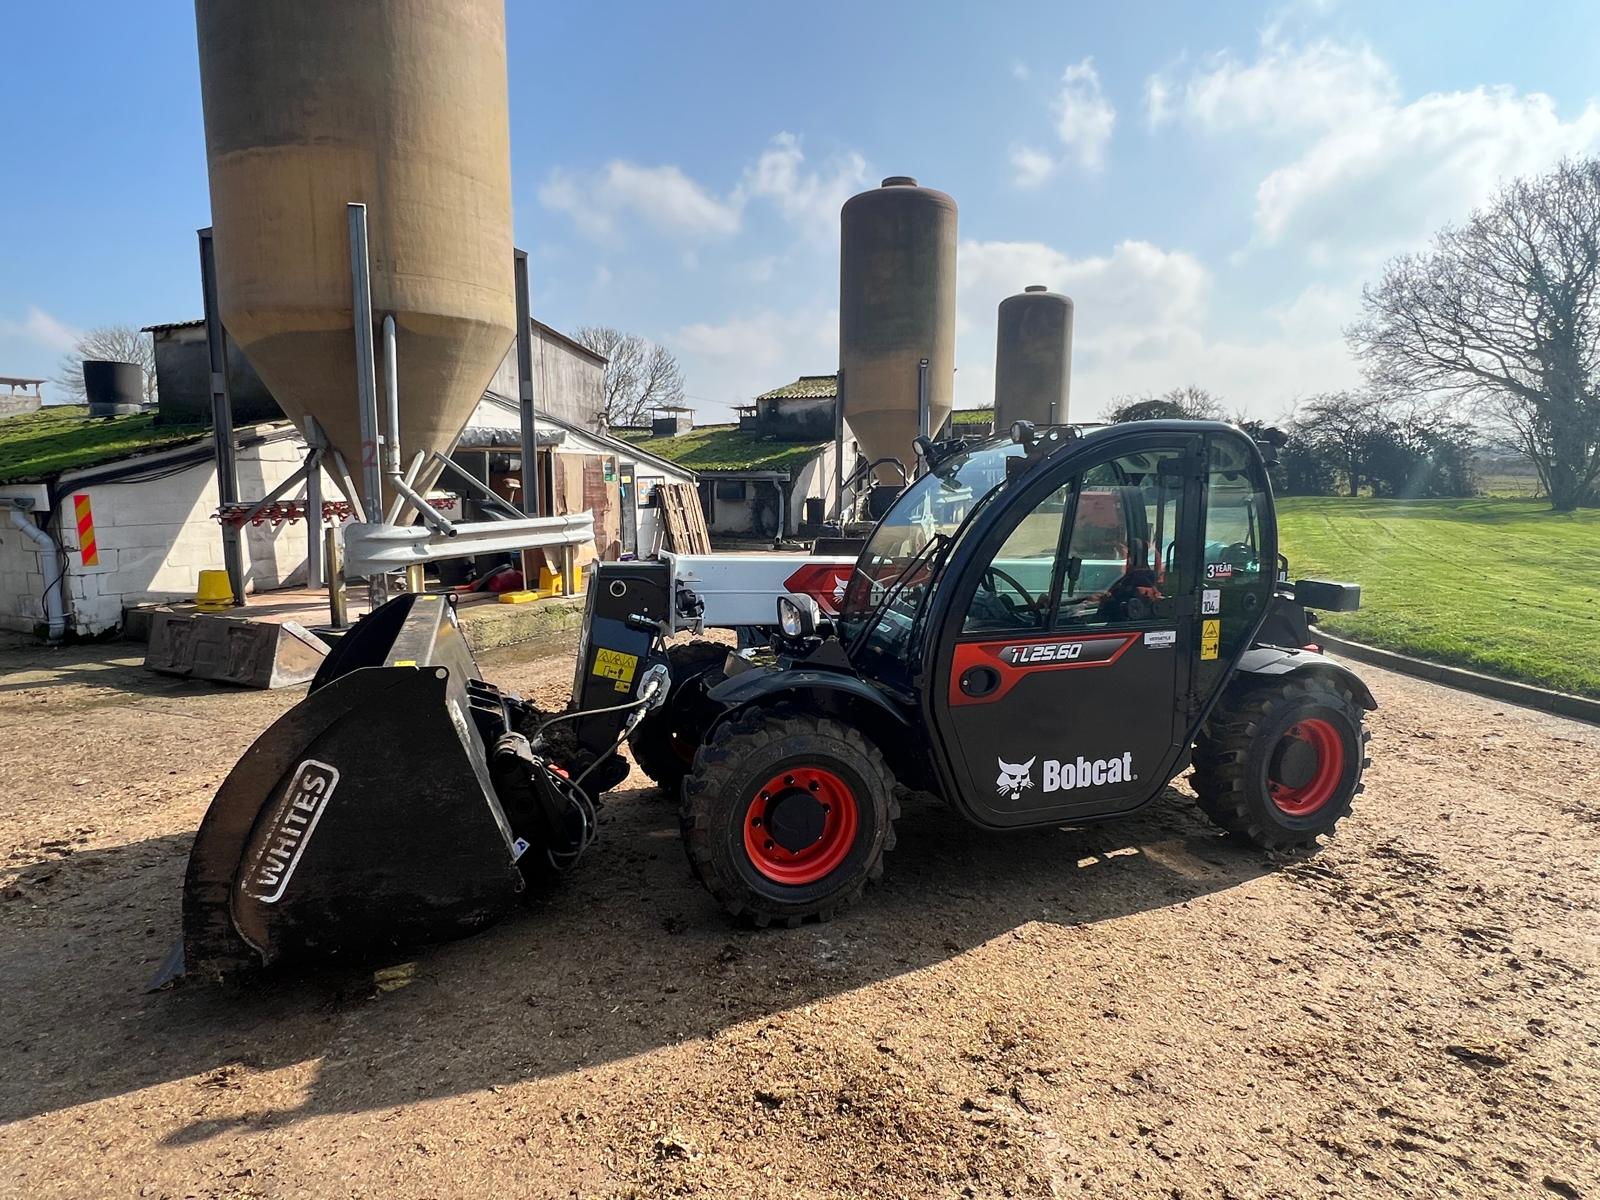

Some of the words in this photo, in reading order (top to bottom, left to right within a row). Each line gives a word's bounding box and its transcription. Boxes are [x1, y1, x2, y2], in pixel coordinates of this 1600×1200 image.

[362, 441, 377, 468] 2
[1207, 564, 1215, 578] 3
[1215, 563, 1232, 573] YEAR
[1203, 601, 1215, 613] 104
[1012, 644, 1083, 663] TL25.60
[1043, 752, 1132, 792] Bobcat
[256, 774, 326, 885] WHITES
